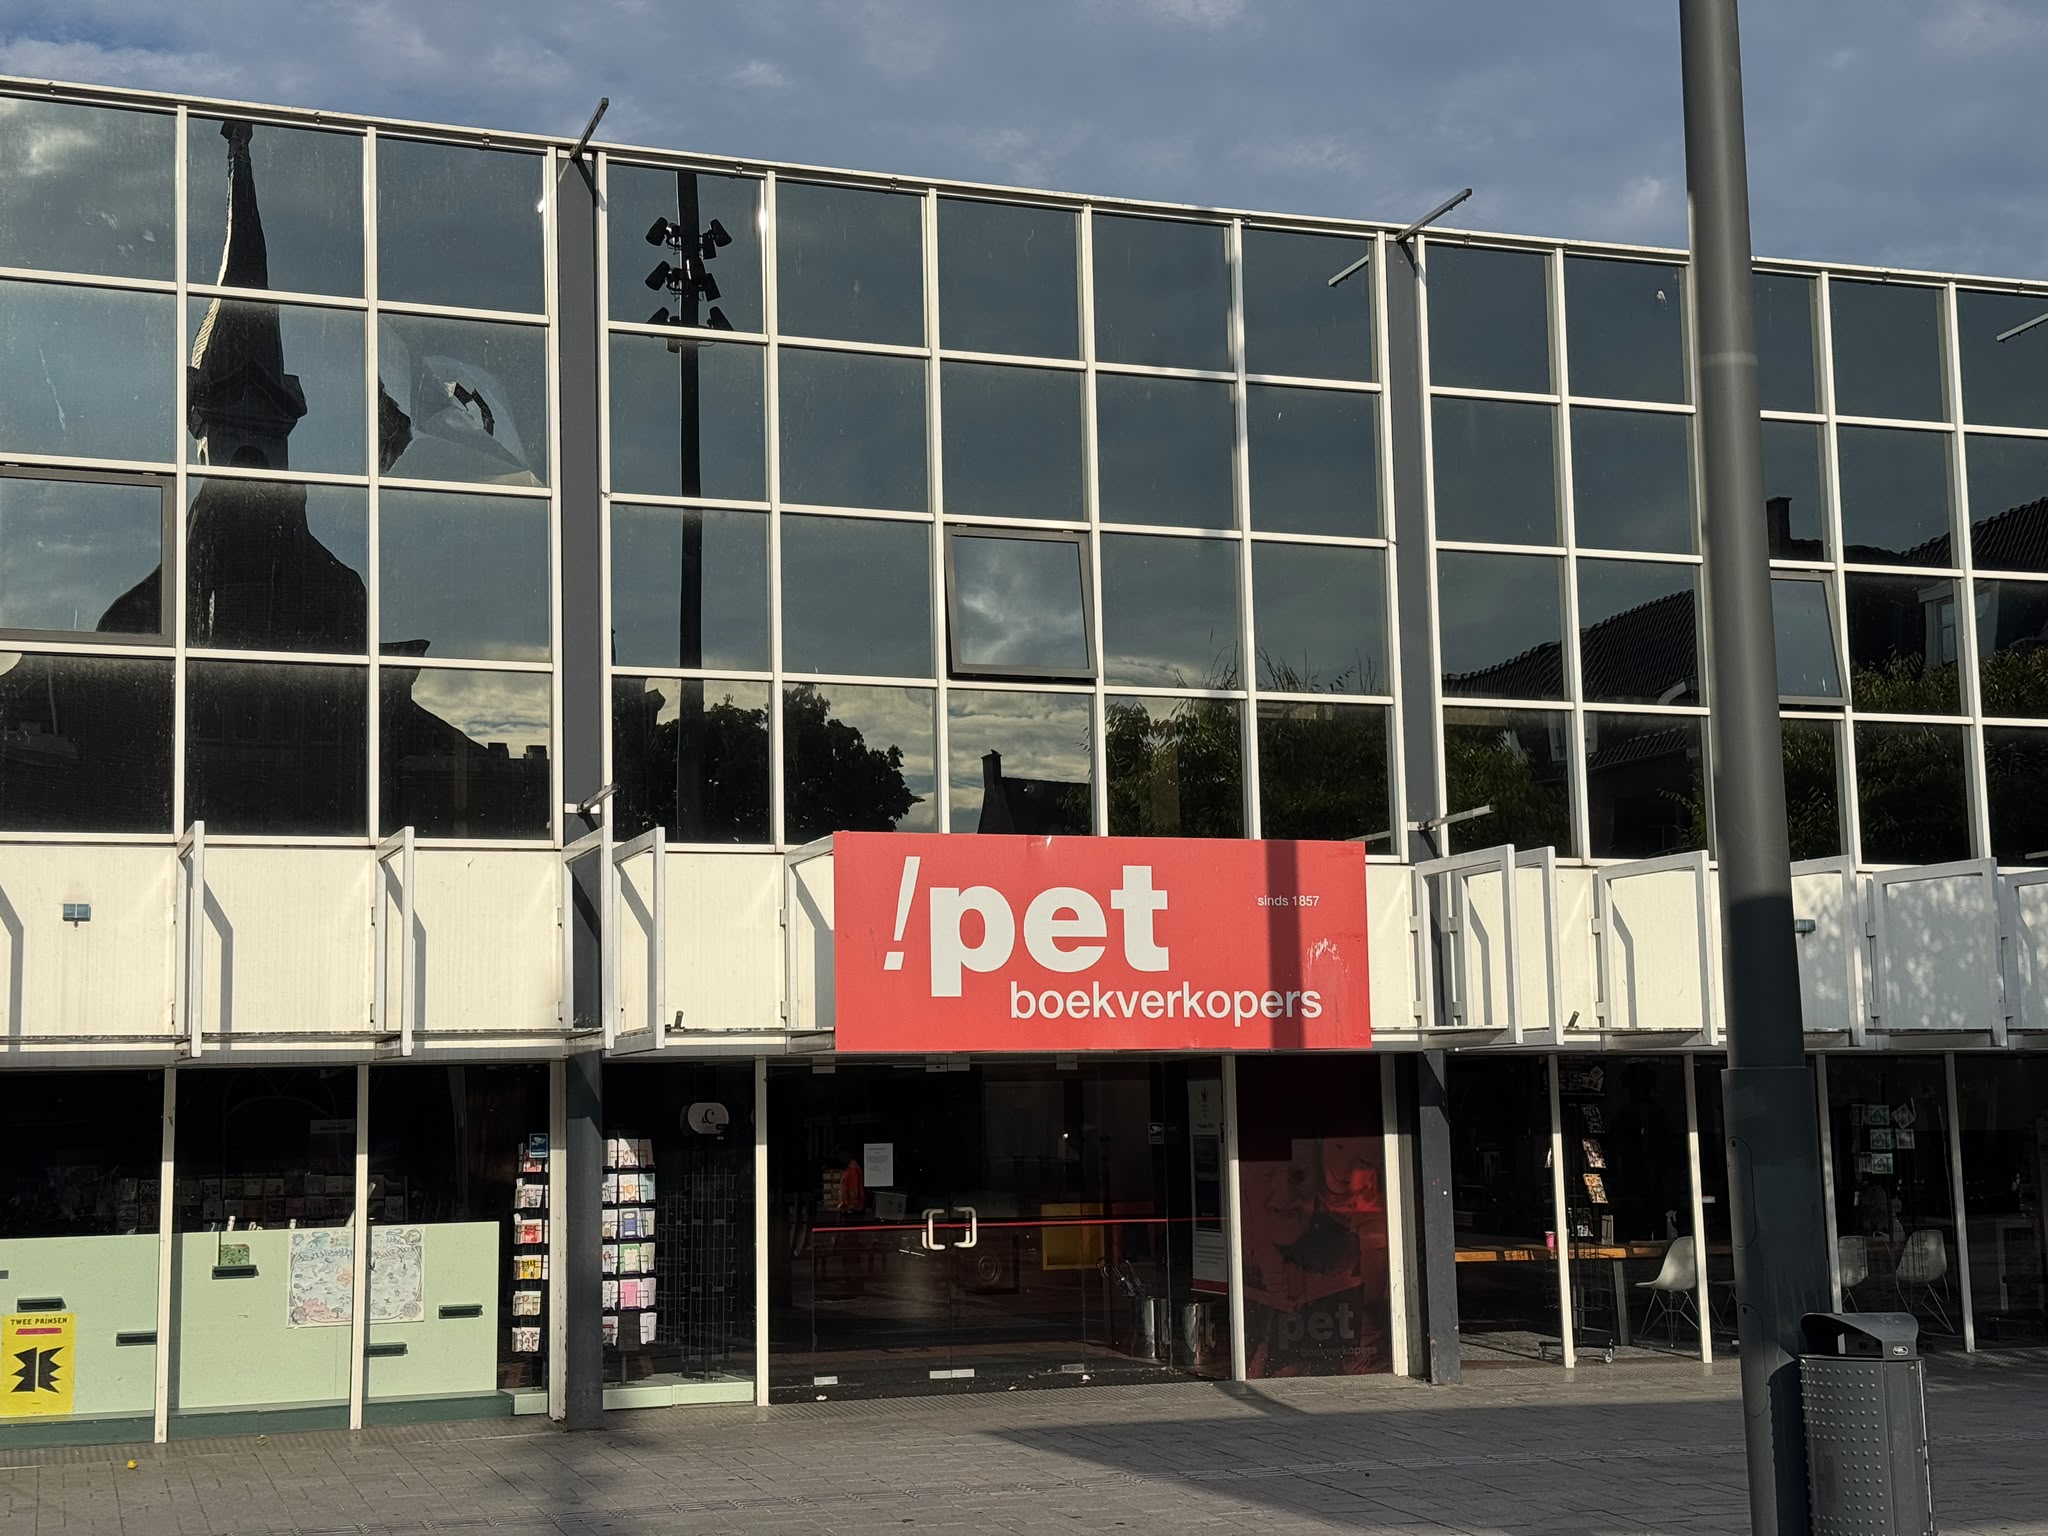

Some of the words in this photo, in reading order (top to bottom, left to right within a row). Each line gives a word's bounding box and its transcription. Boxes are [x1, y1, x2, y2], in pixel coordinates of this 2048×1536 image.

[1257, 894, 1289, 907] sinds
[1292, 894, 1320, 907] 1857
[1010, 981, 1323, 1027] boekverkopers
[35, 1317, 68, 1325] PRINSEN
